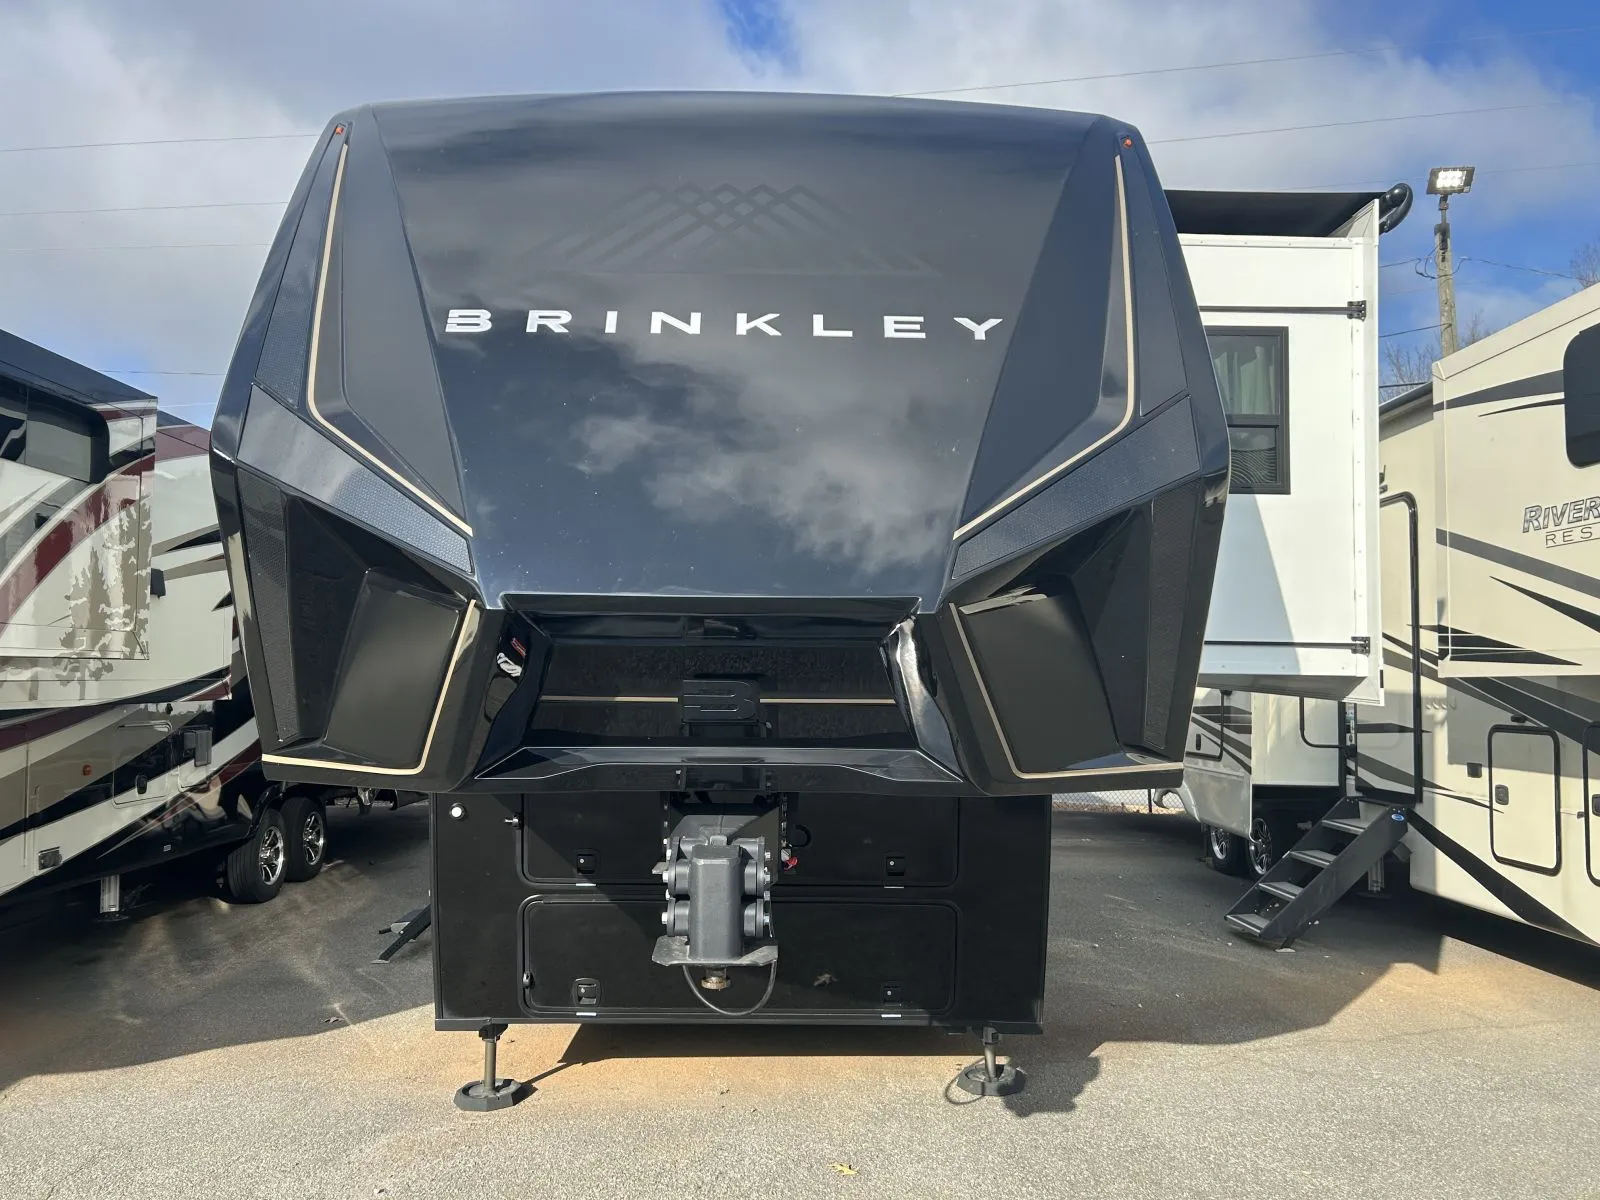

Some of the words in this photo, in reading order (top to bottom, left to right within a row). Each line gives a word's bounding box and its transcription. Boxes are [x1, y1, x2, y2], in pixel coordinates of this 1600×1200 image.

[445, 309, 1003, 341] BRINKLEY
[1522, 495, 1600, 533] RIVER
[1545, 526, 1593, 546] RES
